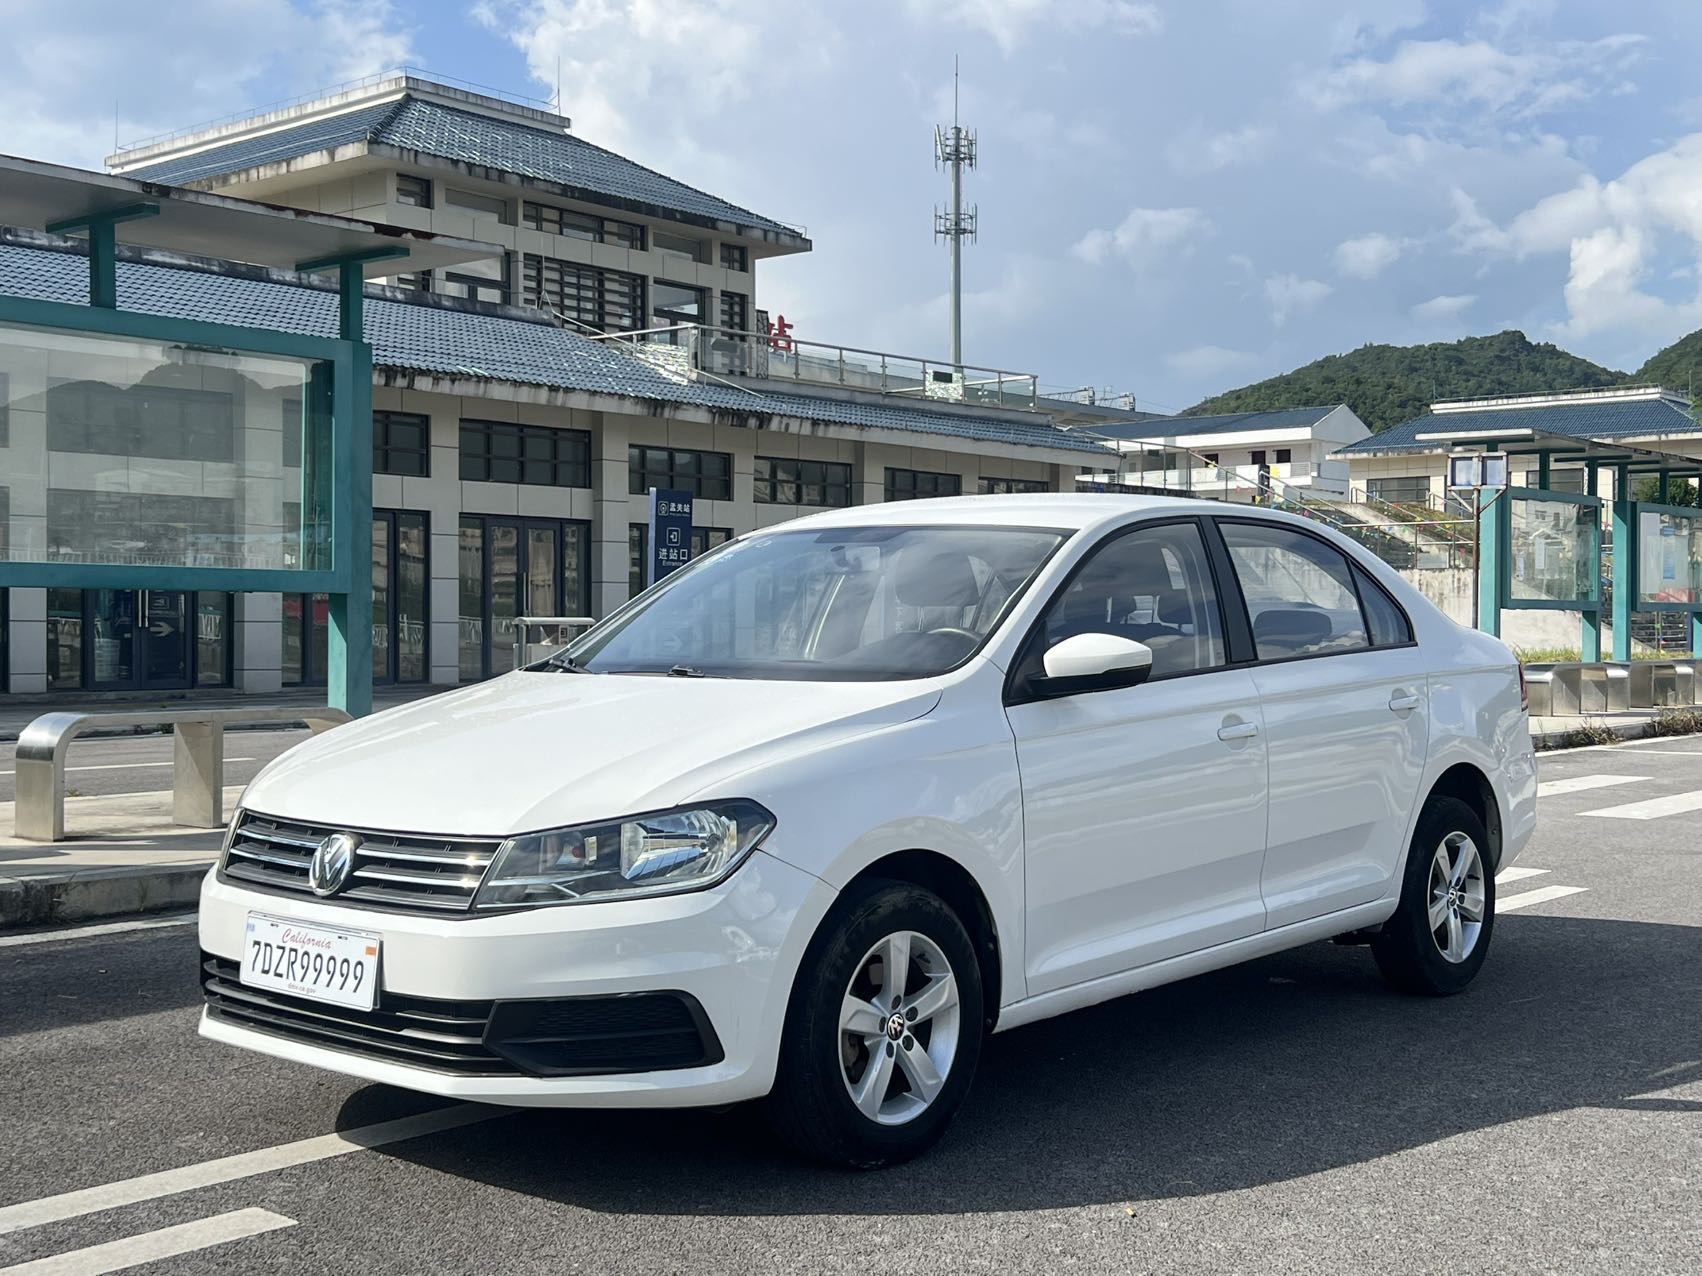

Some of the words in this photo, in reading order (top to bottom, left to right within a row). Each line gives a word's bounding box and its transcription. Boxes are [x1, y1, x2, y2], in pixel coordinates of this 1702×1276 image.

[658, 547, 688, 560] 进站口
[282, 927, 332, 949] California
[251, 940, 364, 993] 7DZR99999
